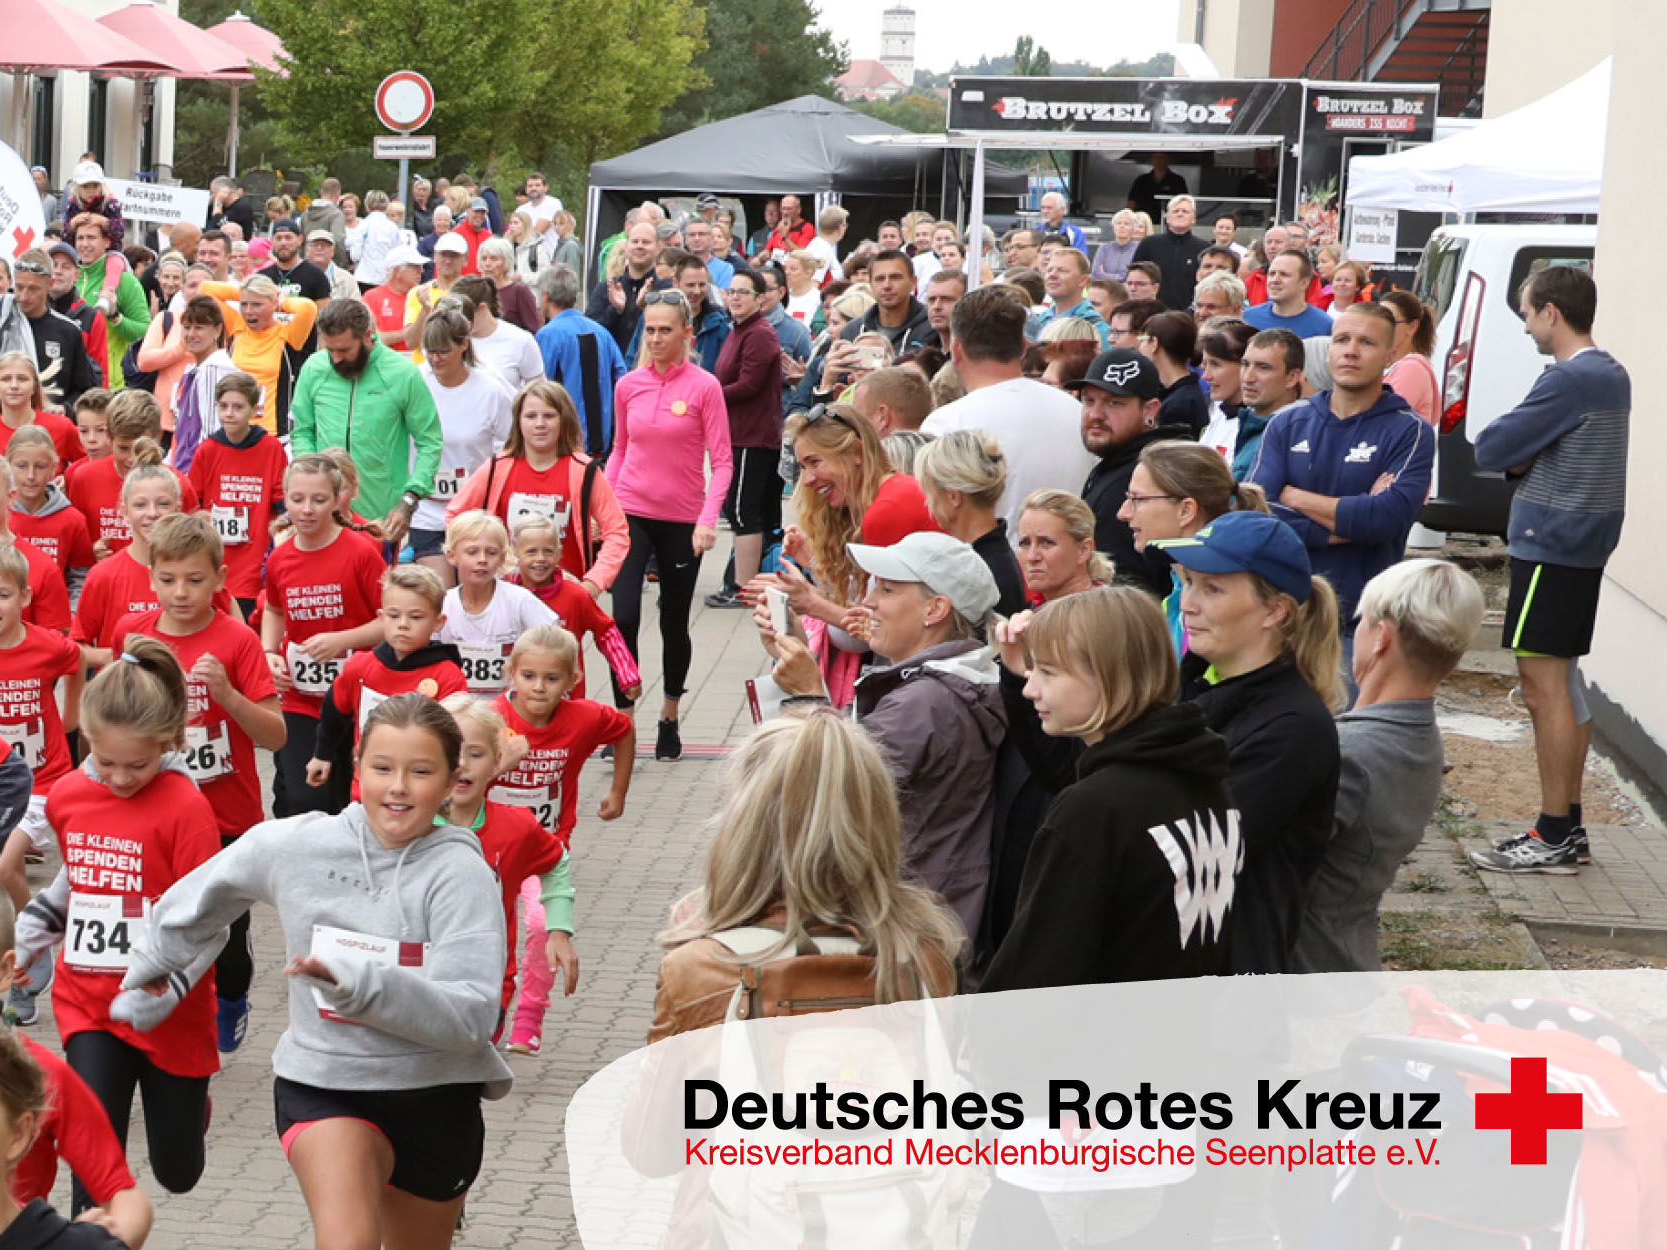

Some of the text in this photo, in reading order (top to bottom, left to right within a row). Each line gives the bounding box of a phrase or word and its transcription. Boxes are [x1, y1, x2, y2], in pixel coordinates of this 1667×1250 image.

[126, 186, 173, 203] Rückgabe
[120, 201, 182, 218] tartnummern
[294, 661, 340, 684] 235
[67, 832, 143, 855] DIE KLEINEN
[67, 847, 142, 873] SPENDEN
[68, 865, 143, 892] HELFEN
[72, 918, 131, 955] 734
